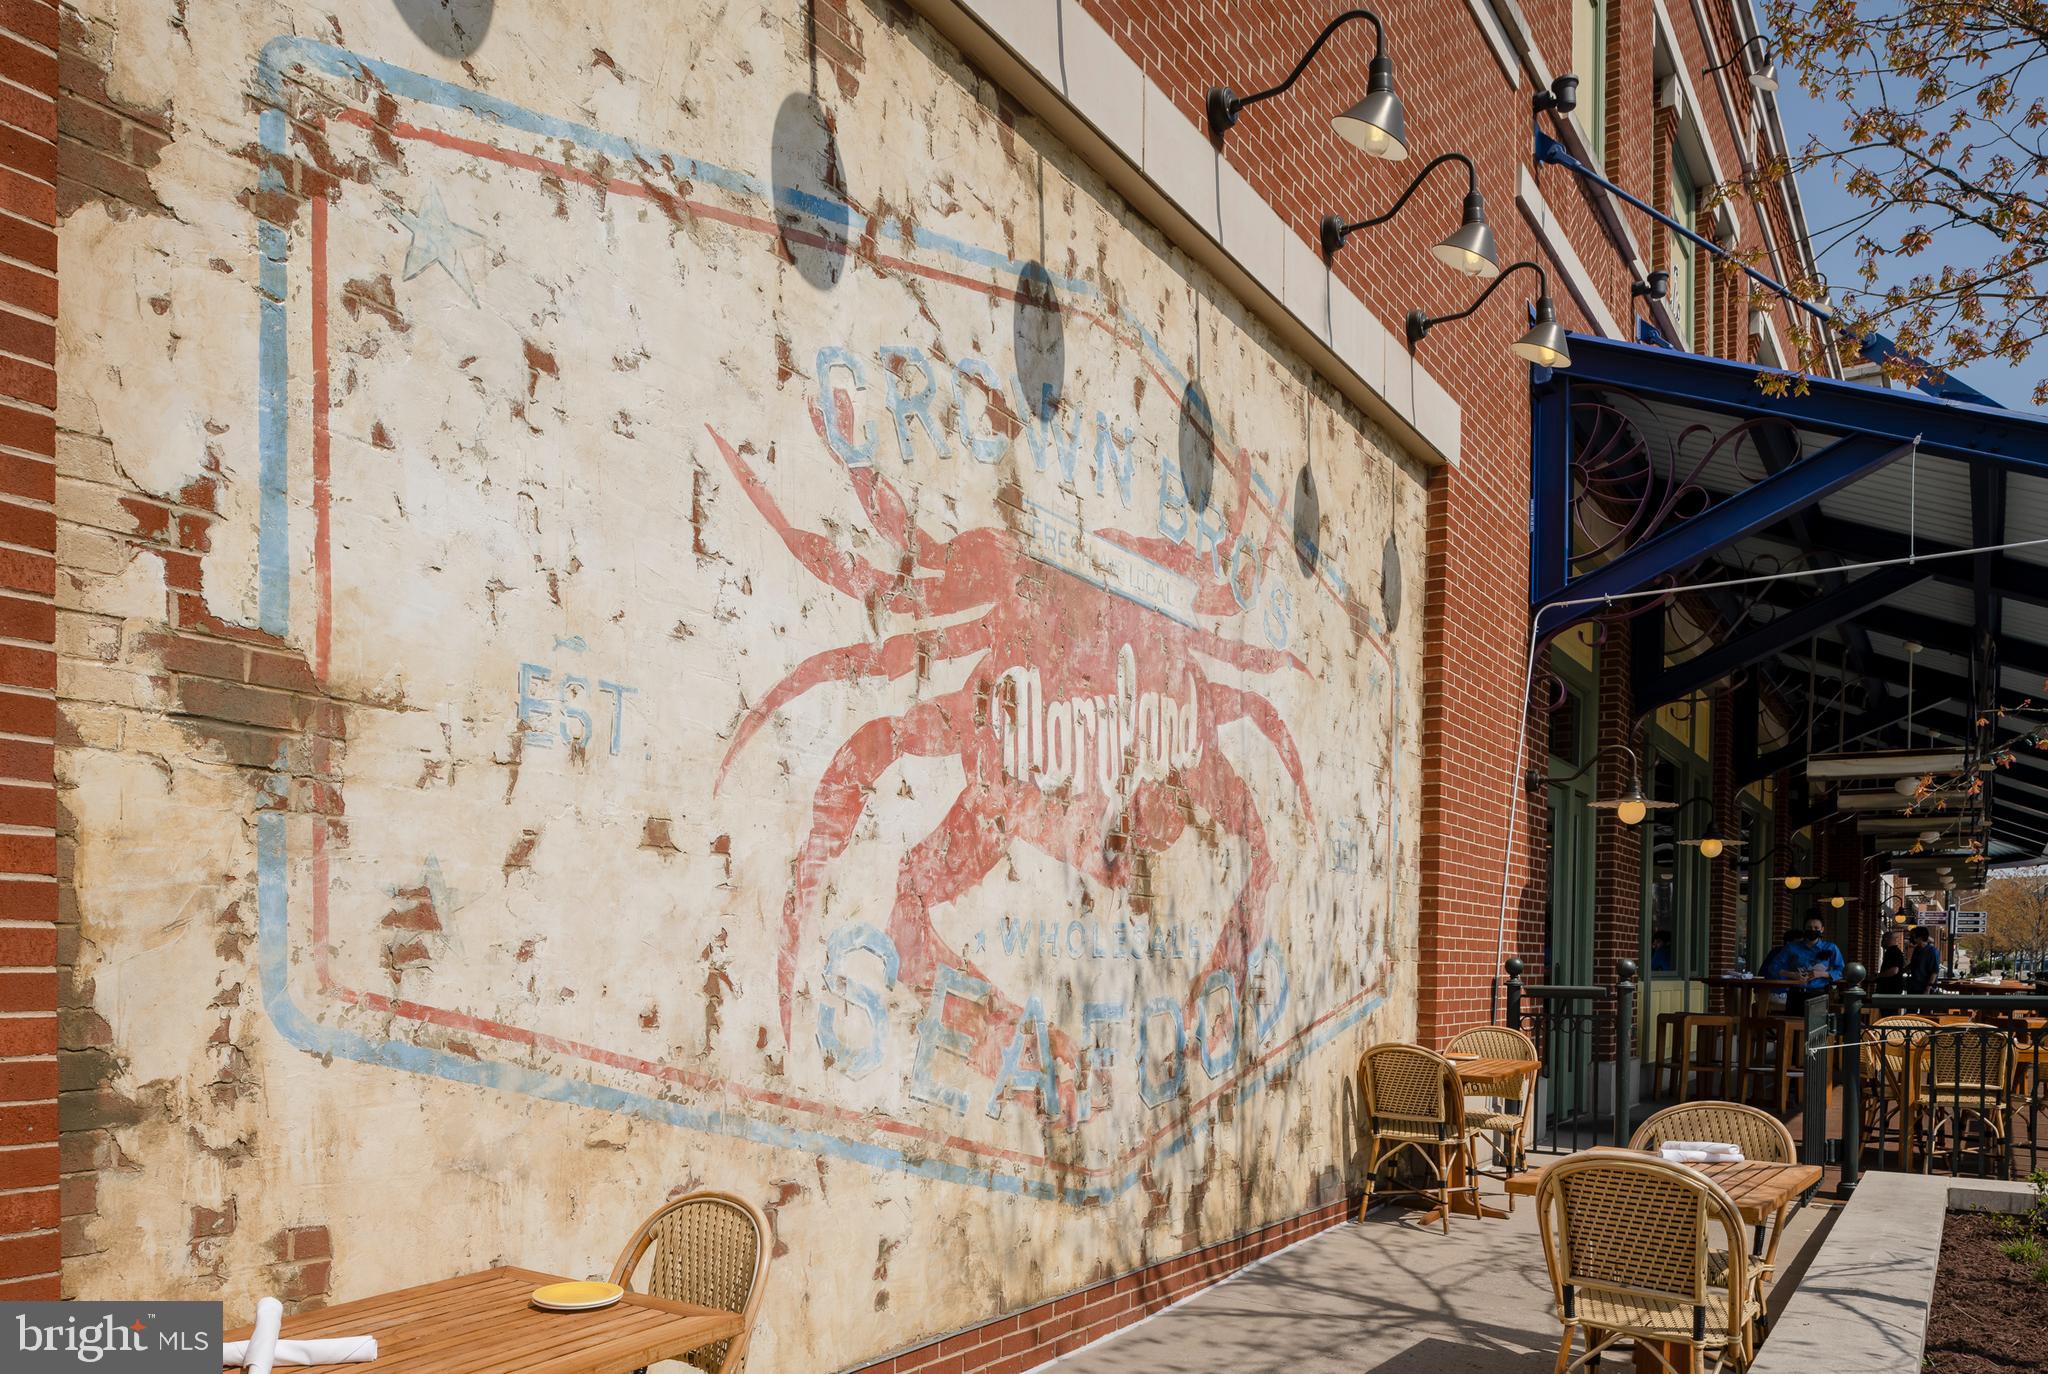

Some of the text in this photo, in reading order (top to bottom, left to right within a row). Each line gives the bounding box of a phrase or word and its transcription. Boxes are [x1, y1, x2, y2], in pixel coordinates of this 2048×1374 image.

[815, 345, 1293, 651] CROWN BROS
[1029, 516, 1093, 569] FRESH
[1129, 563, 1174, 606] LOCAL
[991, 642, 1204, 838] Maryland
[815, 920, 1289, 1134] SEAFOOD
[999, 916, 1201, 960] WHOLESALE
